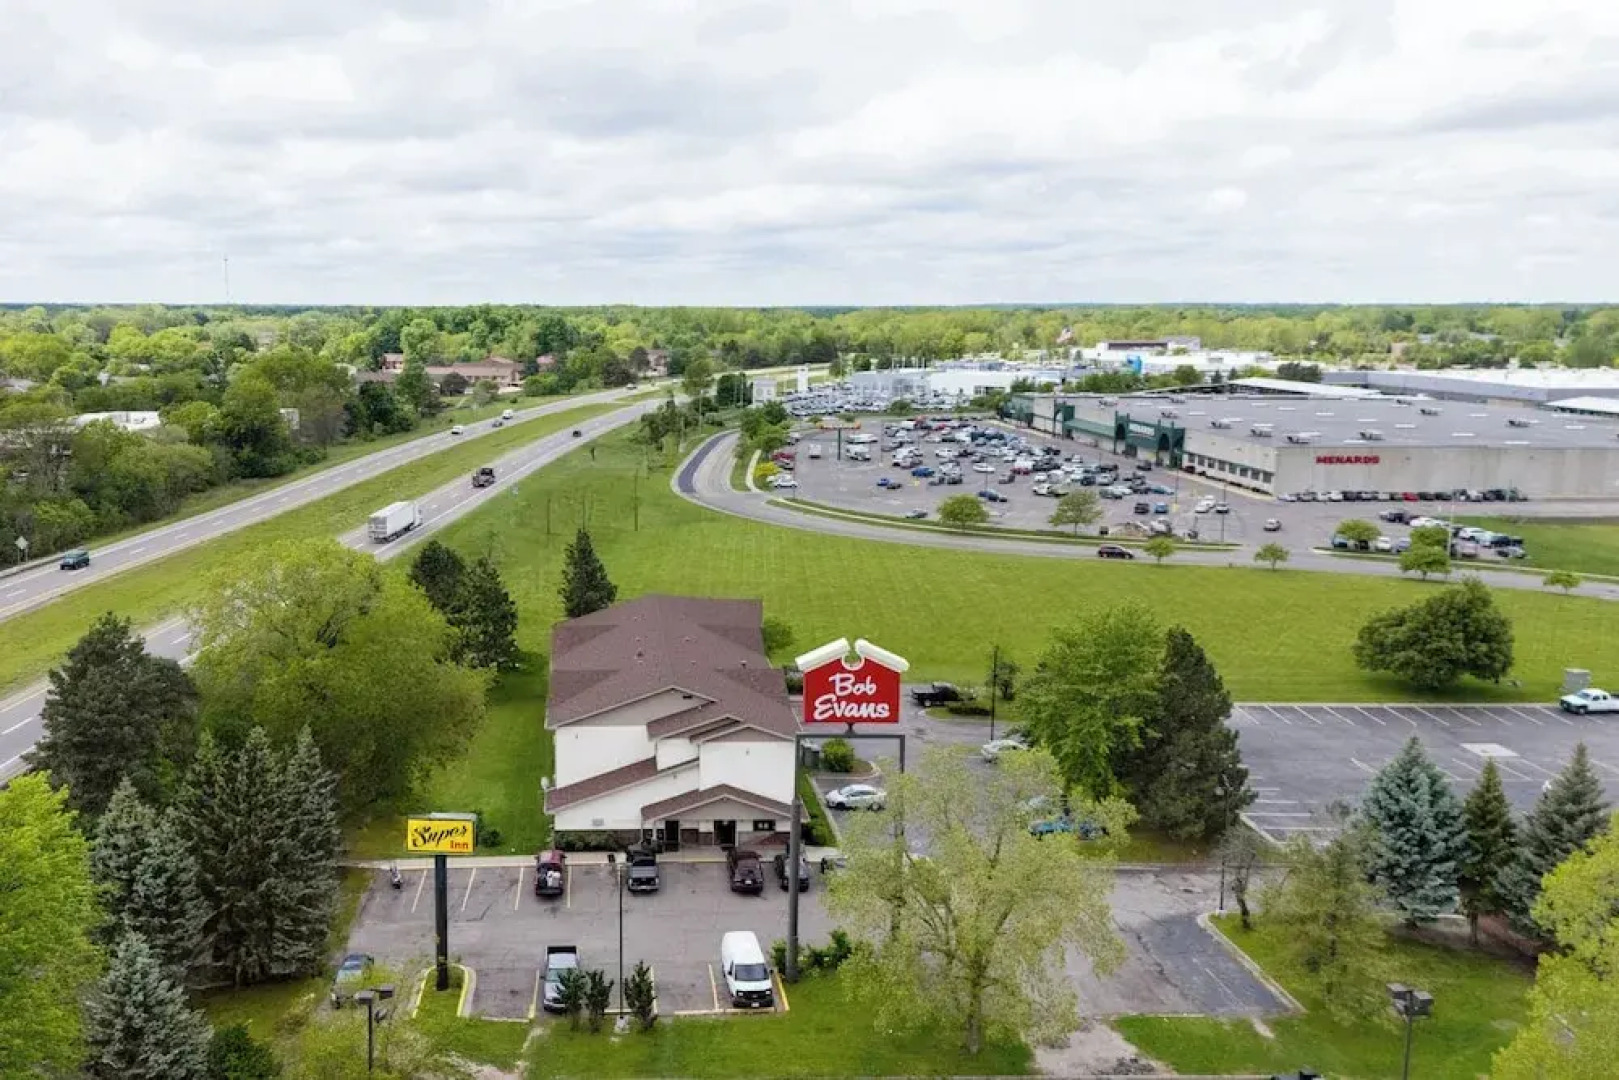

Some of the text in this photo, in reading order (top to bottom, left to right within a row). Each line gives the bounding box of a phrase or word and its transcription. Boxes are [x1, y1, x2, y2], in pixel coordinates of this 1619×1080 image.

[1315, 455, 1380, 464] MENARDS
[828, 672, 877, 696] Bob
[813, 693, 891, 720] Evans
[450, 840, 469, 849] Inn
